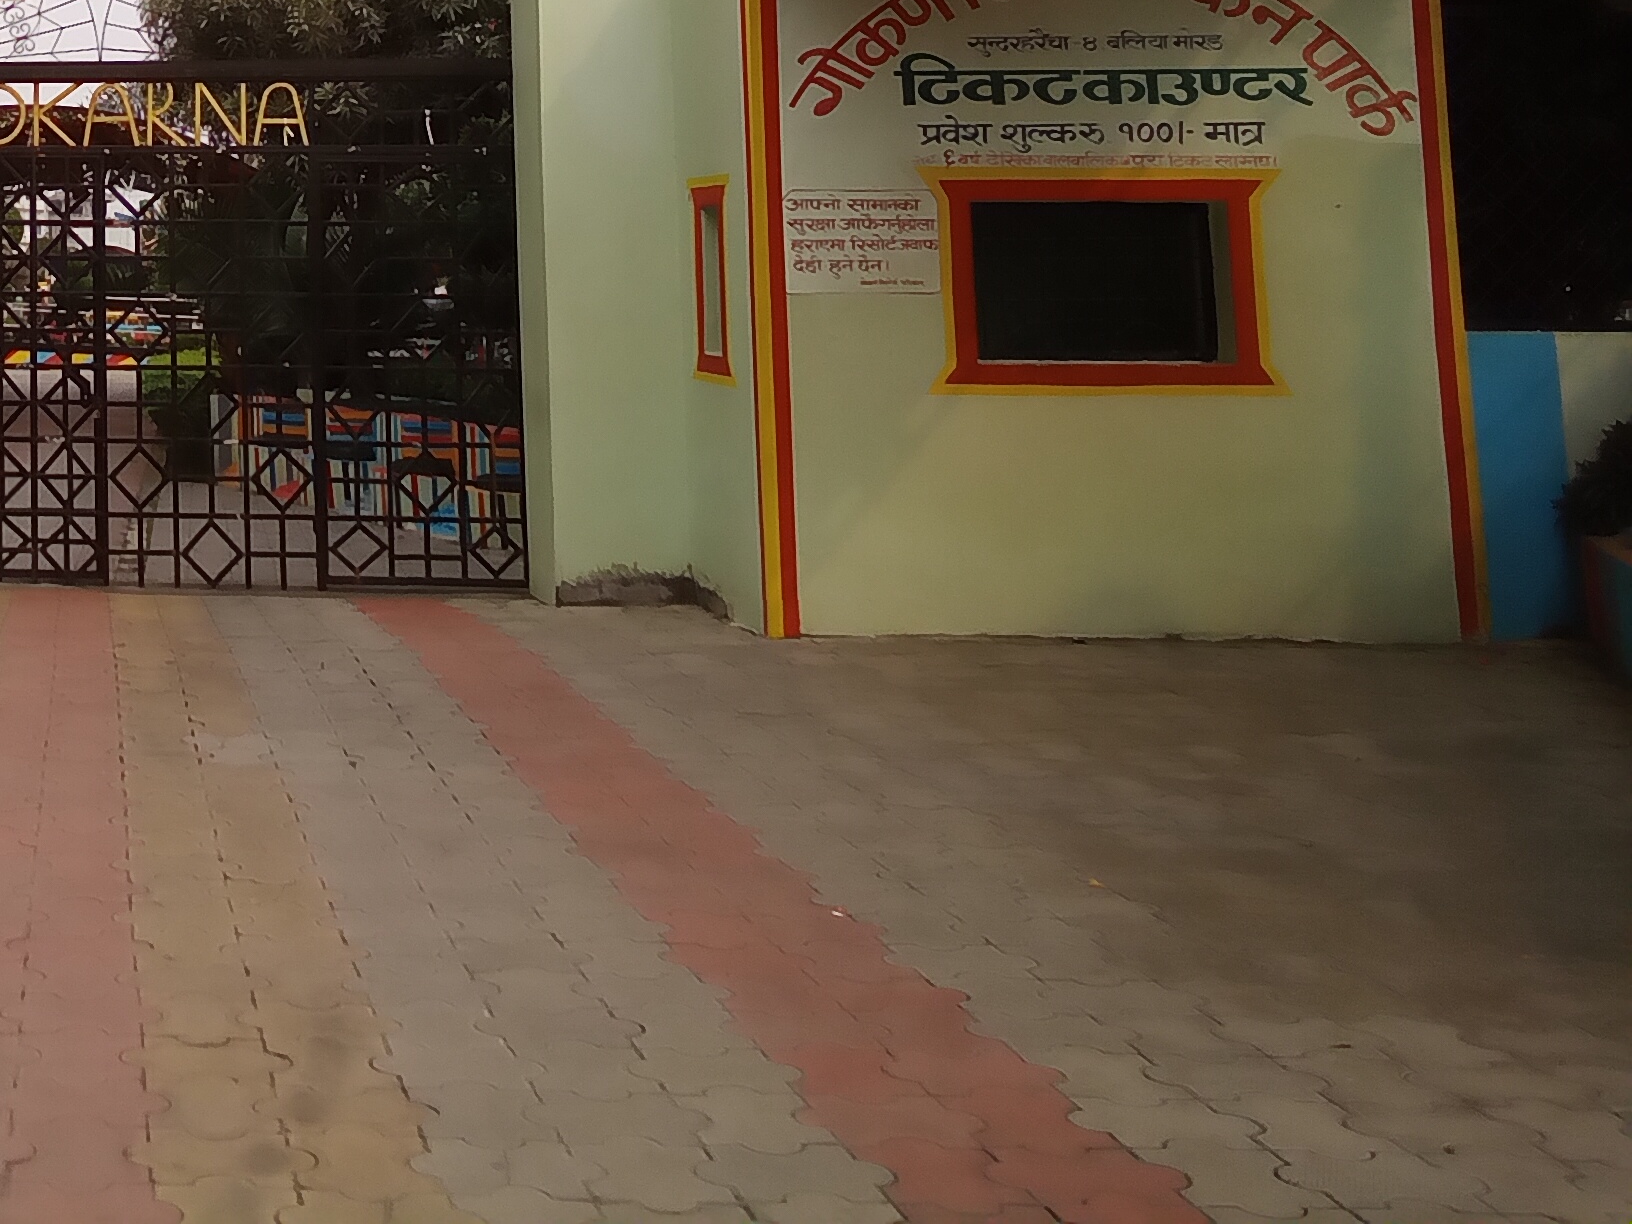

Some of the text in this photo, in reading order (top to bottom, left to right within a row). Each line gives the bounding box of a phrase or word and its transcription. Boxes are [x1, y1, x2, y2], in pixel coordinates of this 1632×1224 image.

[1302, 19, 1417, 137] पार्क
[917, 114, 993, 146] प्रवेश
[1203, 121, 1266, 146] मात्र
